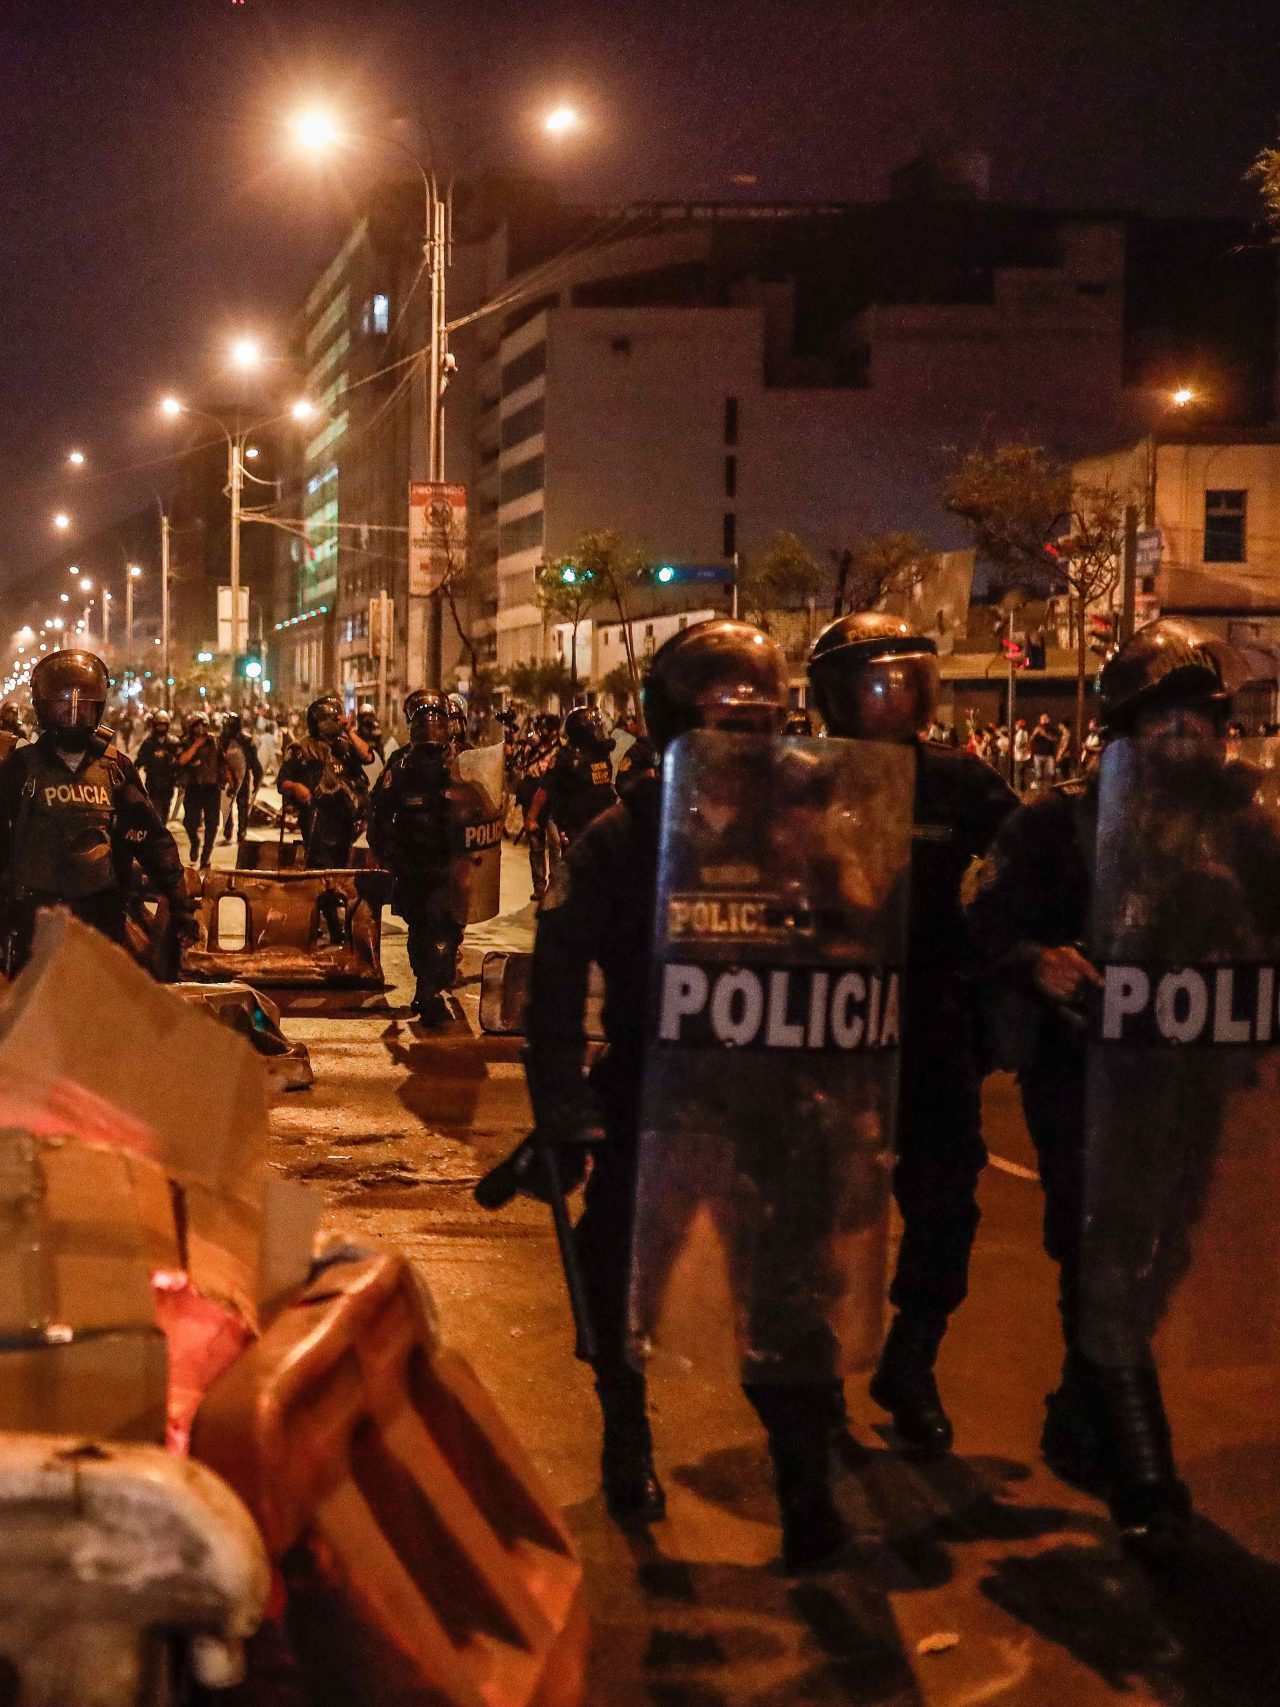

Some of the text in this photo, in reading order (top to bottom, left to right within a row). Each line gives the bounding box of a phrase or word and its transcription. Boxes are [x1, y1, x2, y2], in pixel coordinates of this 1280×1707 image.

[44, 784, 111, 806] POLICIA
[668, 901, 768, 934] POLIC
[656, 963, 901, 1048] POLICIA
[1101, 965, 1280, 1043] POLI
